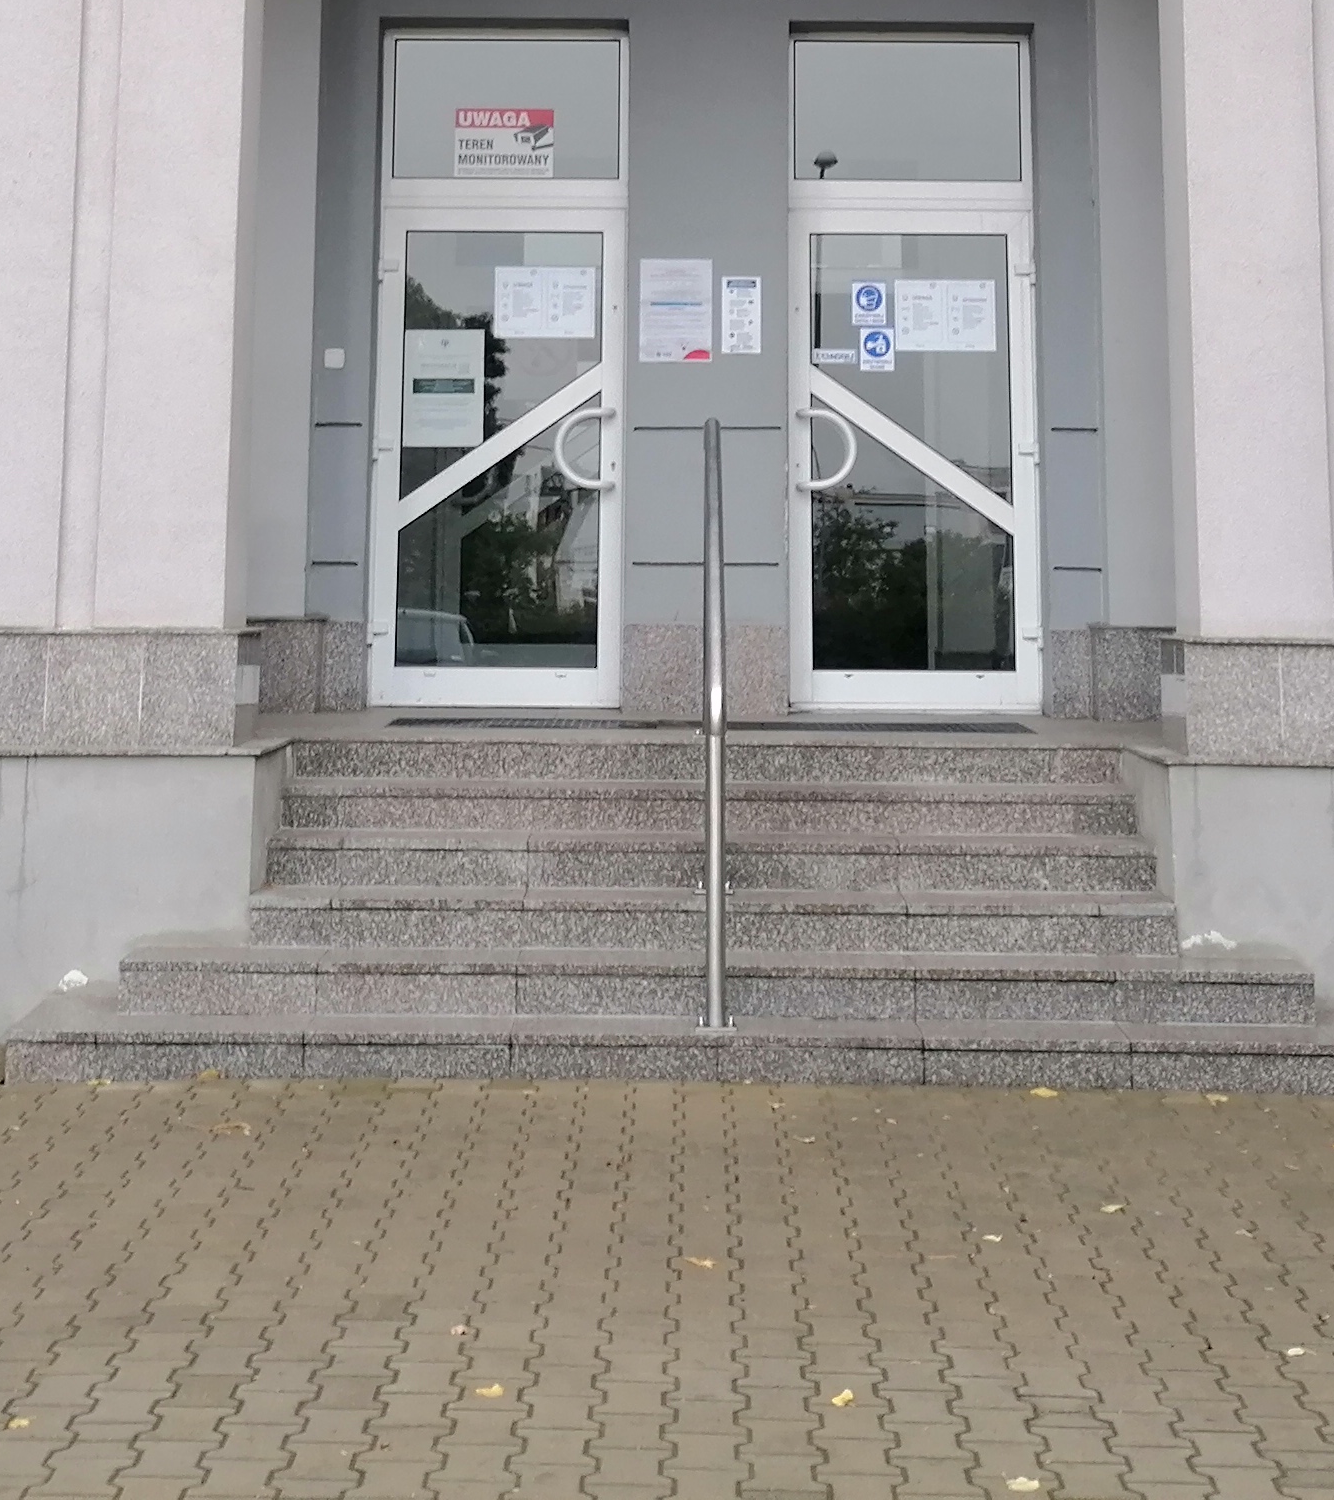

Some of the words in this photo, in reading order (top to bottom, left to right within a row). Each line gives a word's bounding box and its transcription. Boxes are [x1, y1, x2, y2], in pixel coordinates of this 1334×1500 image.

[458, 110, 531, 127] UWAGA
[458, 138, 494, 150] TEREN
[458, 153, 549, 166] MONITOROWANY
